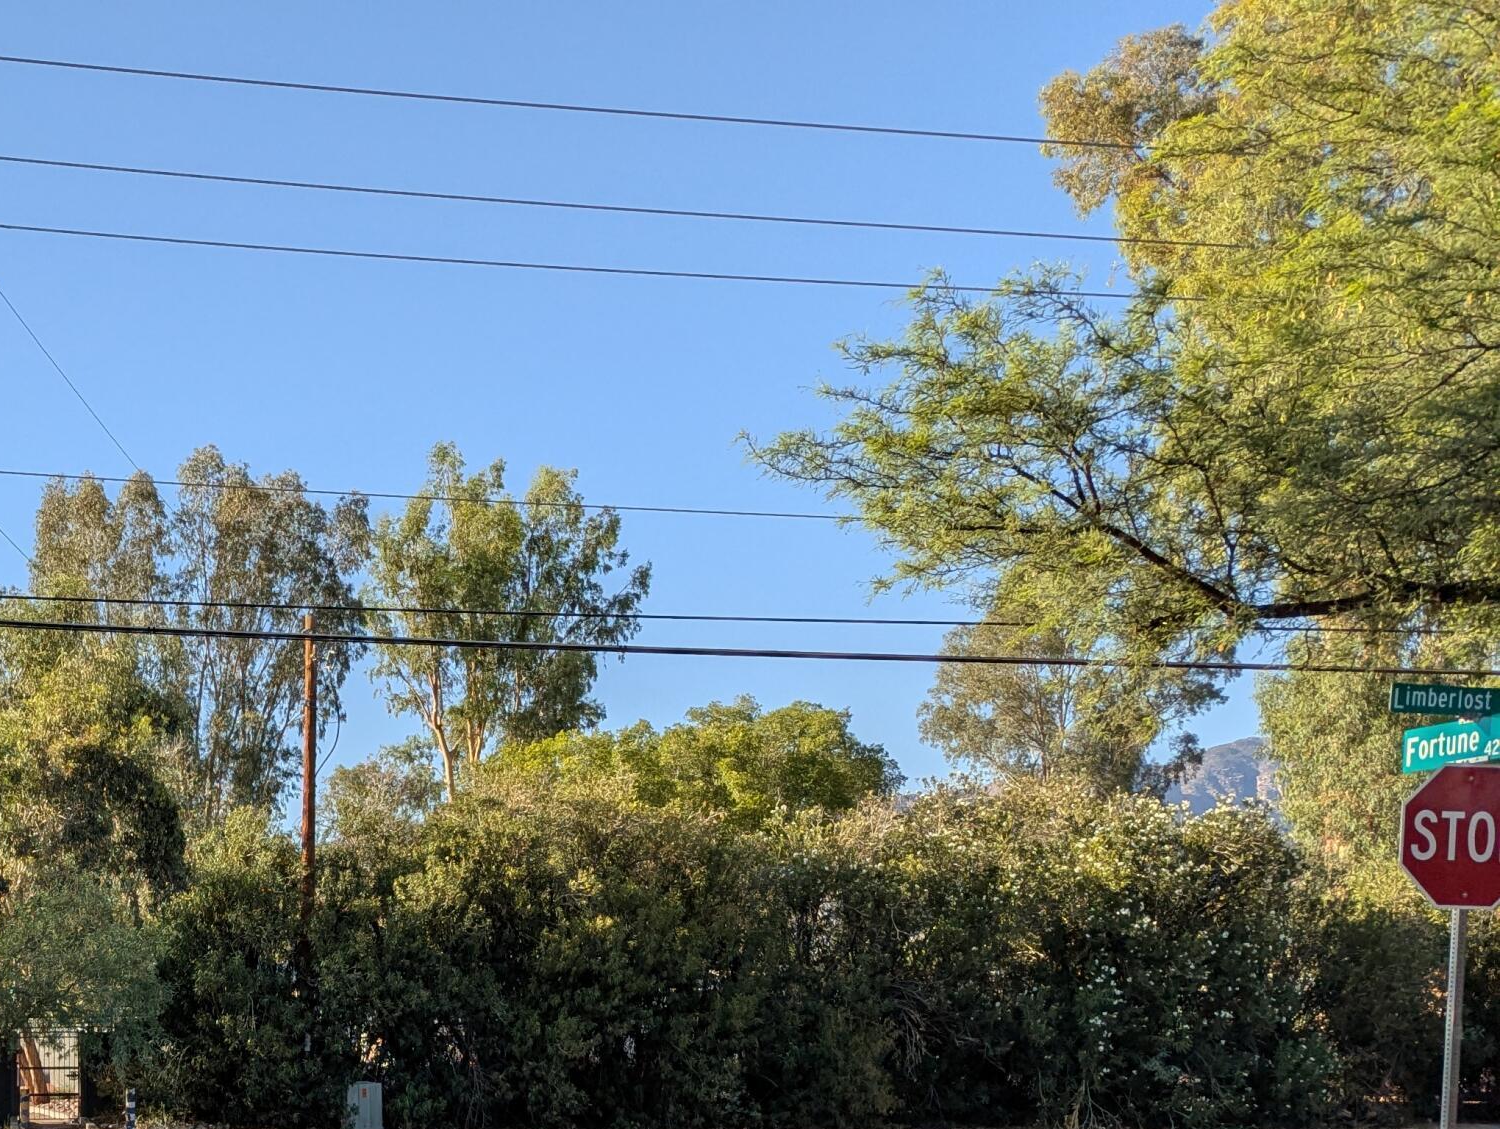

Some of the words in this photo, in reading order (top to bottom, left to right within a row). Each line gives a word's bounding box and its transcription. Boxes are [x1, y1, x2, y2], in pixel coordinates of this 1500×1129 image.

[1394, 685, 1492, 710] Limberlost
[1405, 731, 1479, 767] Fortune
[1410, 809, 1500, 863] STO
